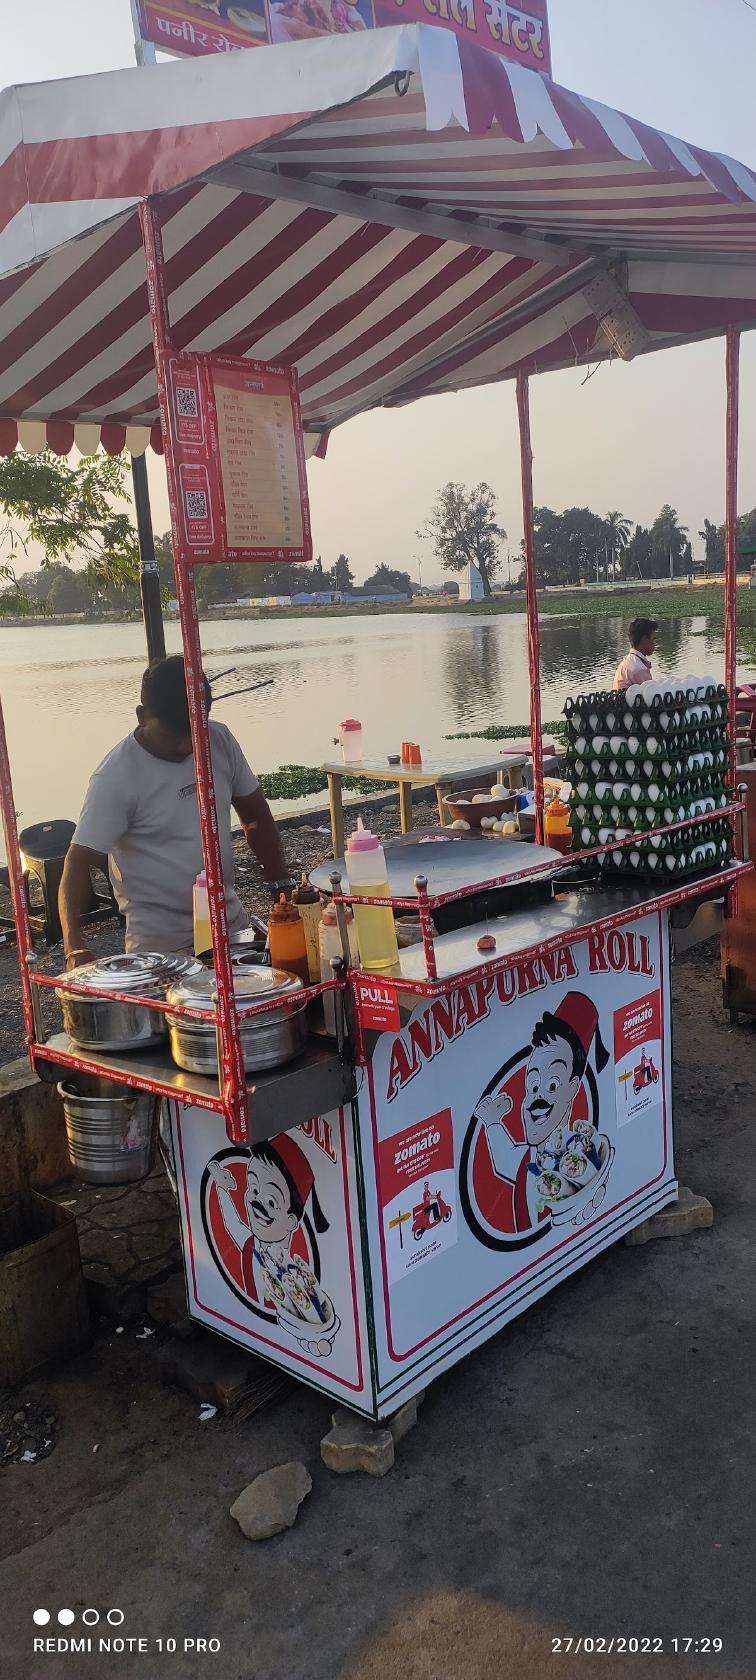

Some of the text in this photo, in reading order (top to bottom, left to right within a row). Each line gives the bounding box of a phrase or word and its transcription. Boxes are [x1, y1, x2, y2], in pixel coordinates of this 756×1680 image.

[156, 17, 208, 46] पनीर
[219, 908, 227, 937] zomato
[360, 987, 394, 1005] PULL
[386, 931, 655, 1103] ANNAPURNA ROLL
[622, 1007, 653, 1031] zomato
[239, 1106, 247, 1133] zomato
[394, 1131, 441, 1166] zomato
